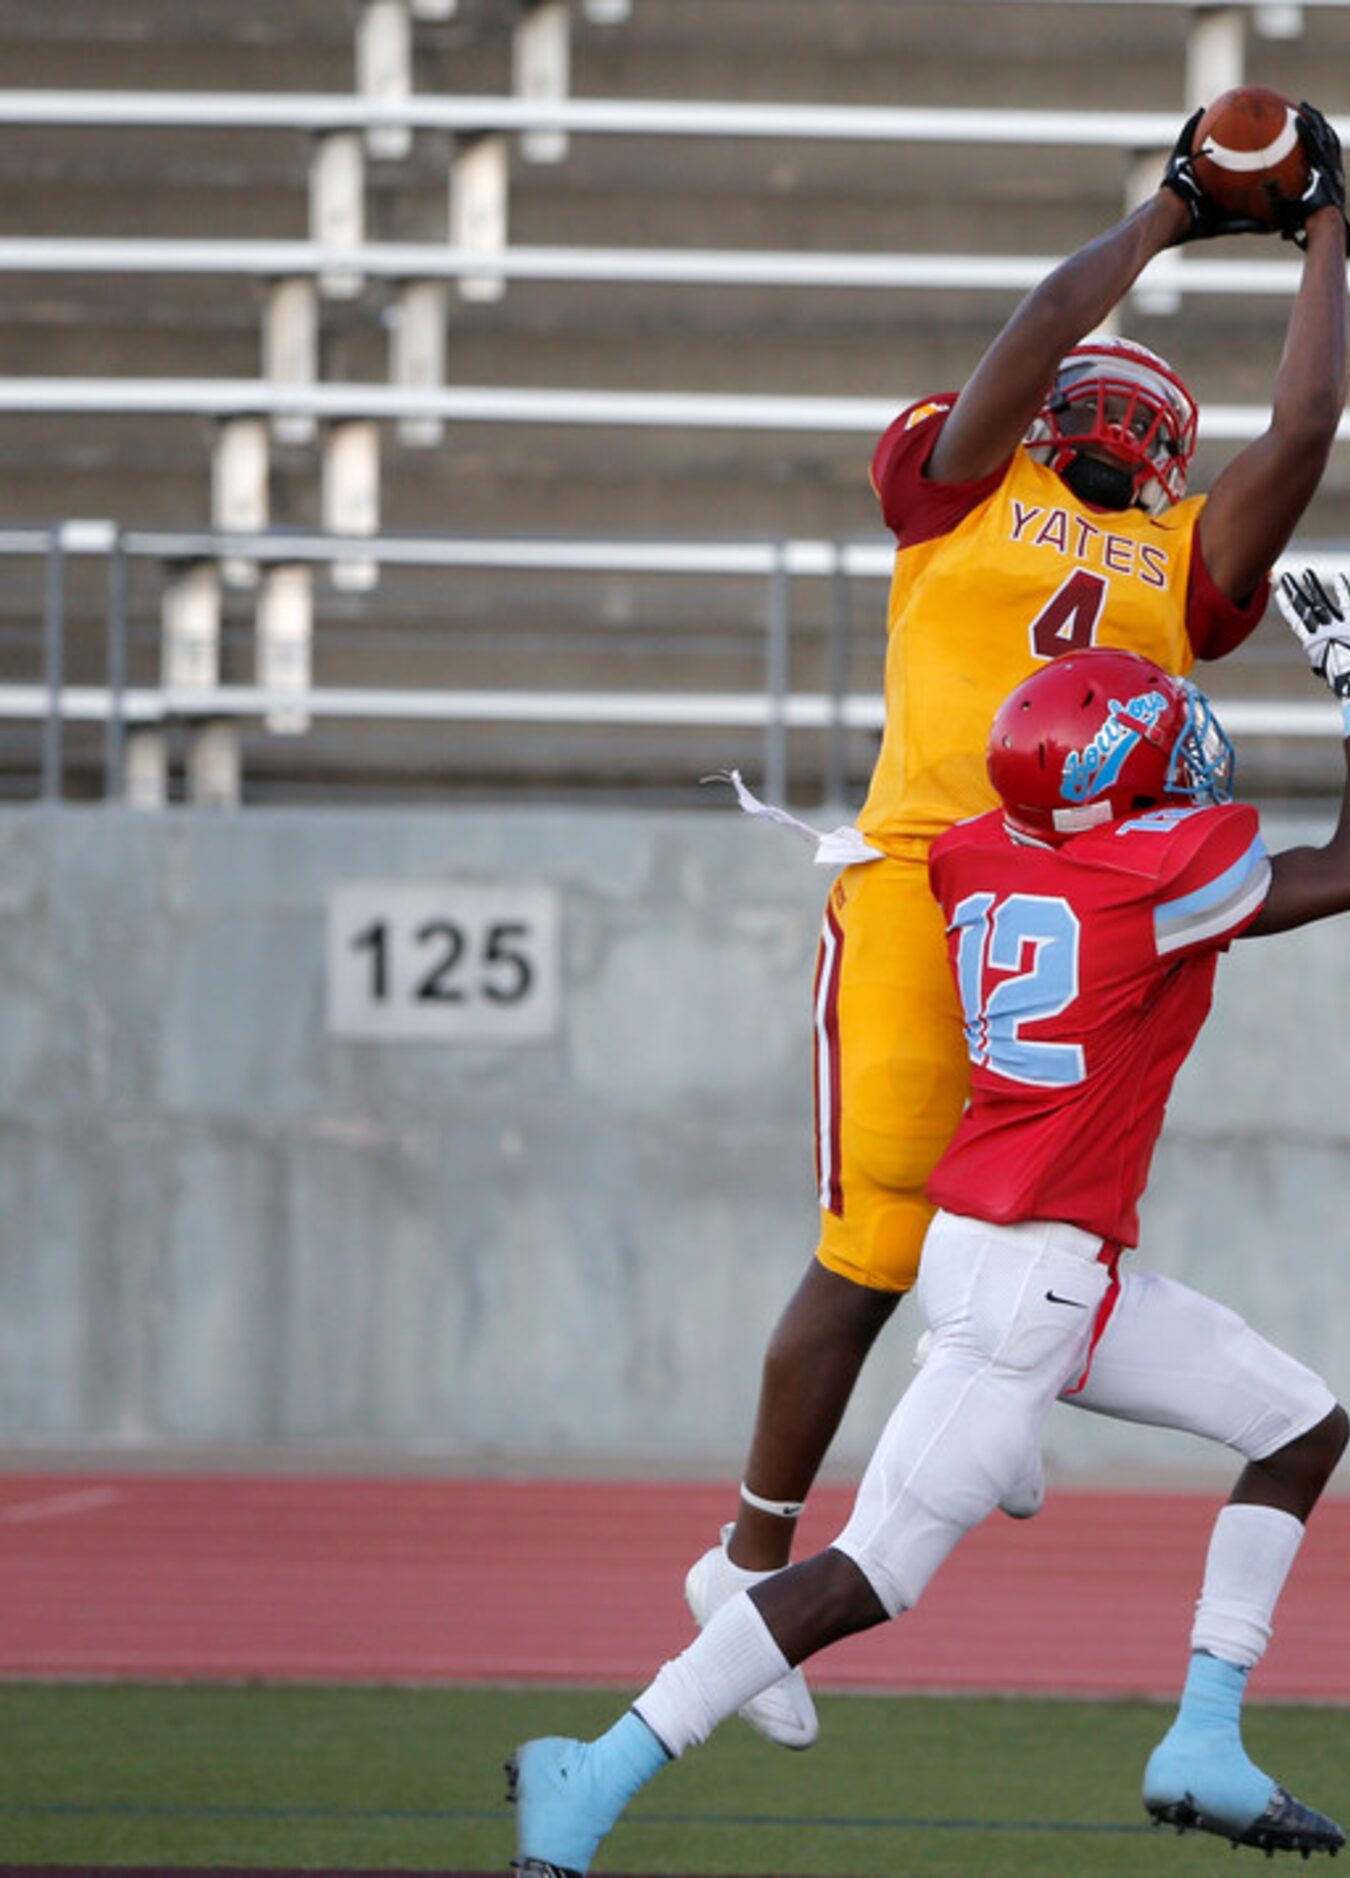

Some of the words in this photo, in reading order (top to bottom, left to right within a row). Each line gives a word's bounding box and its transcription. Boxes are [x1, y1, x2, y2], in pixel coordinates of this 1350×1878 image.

[1009, 499, 1168, 591] YATES
[1028, 566, 1109, 660] 4
[349, 916, 534, 1006] 125
[950, 892, 1087, 1087] 12
